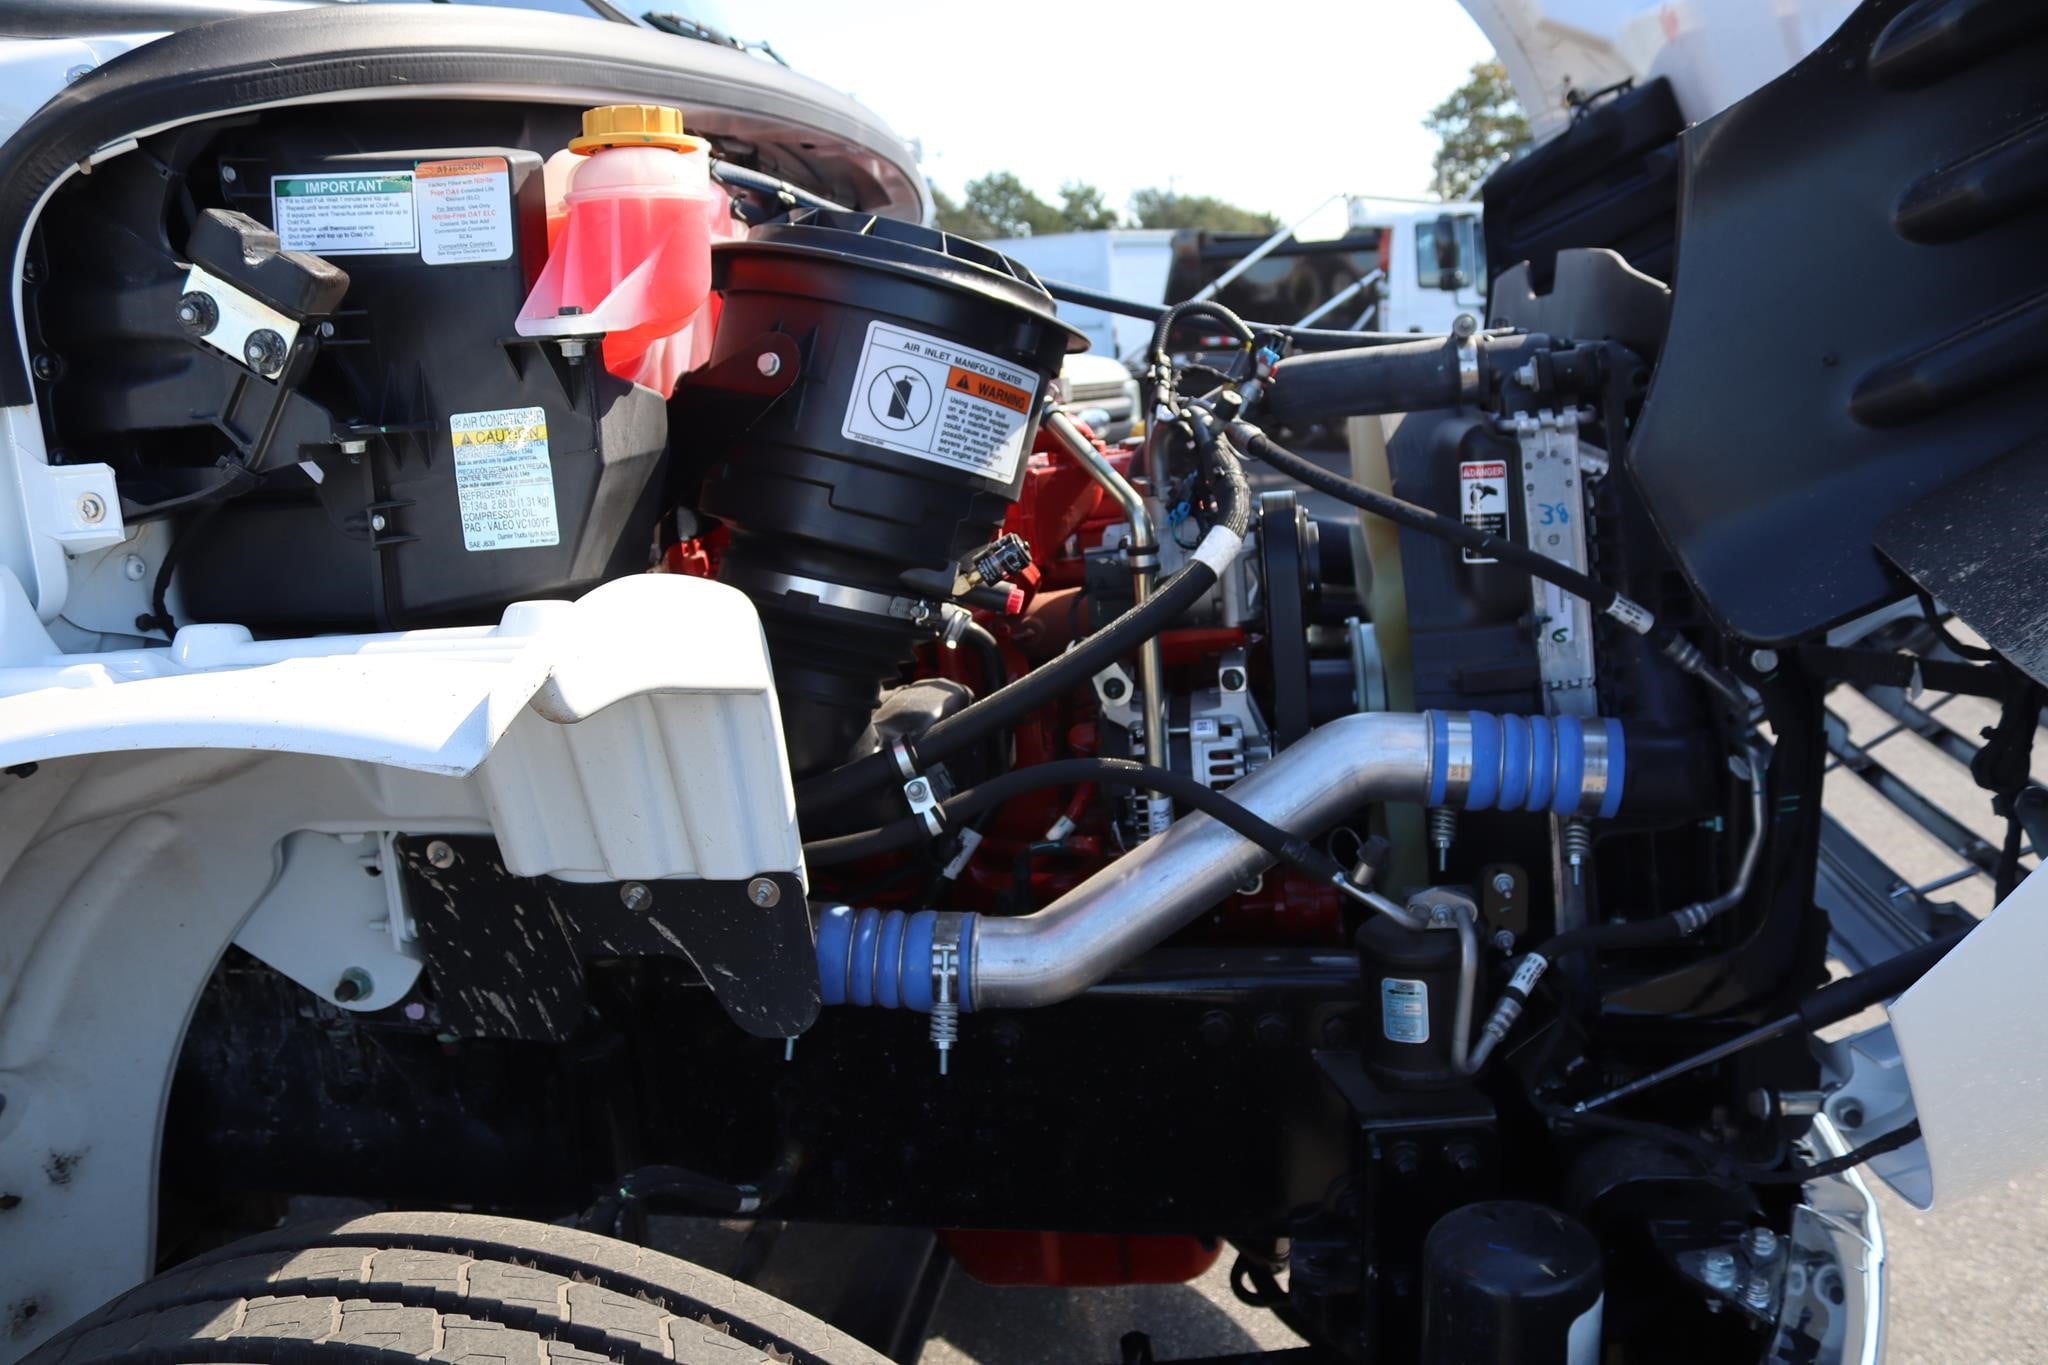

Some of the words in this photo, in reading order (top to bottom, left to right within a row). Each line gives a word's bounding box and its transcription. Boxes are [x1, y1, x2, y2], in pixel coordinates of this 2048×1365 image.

[305, 180, 382, 193] IMPORTANT
[904, 342, 920, 353] AIR
[924, 345, 951, 361] INLET
[955, 356, 995, 376] MANIFOLD
[998, 370, 1022, 385] HEATER
[977, 382, 1026, 410] WARNING
[950, 396, 968, 409] Using
[972, 404, 992, 416] starting
[463, 416, 477, 429] AIR
[968, 411, 987, 421] engine
[944, 422, 961, 431] could
[963, 428, 980, 436] cause
[968, 420, 991, 431] manifold
[993, 427, 1006, 436] heater
[940, 438, 960, 448] severe
[963, 445, 987, 455] personal
[941, 430, 968, 442] possibly
[971, 438, 994, 451] resulting
[952, 450, 972, 459] engine
[1470, 466, 1504, 476] DANGER
[462, 501, 487, 511] R-134a
[463, 510, 520, 521] COMPRESSOR
[1537, 502, 1568, 525] 38
[465, 522, 481, 532] PAG
[487, 520, 514, 530] VALEO
[517, 517, 550, 528] VC100YF
